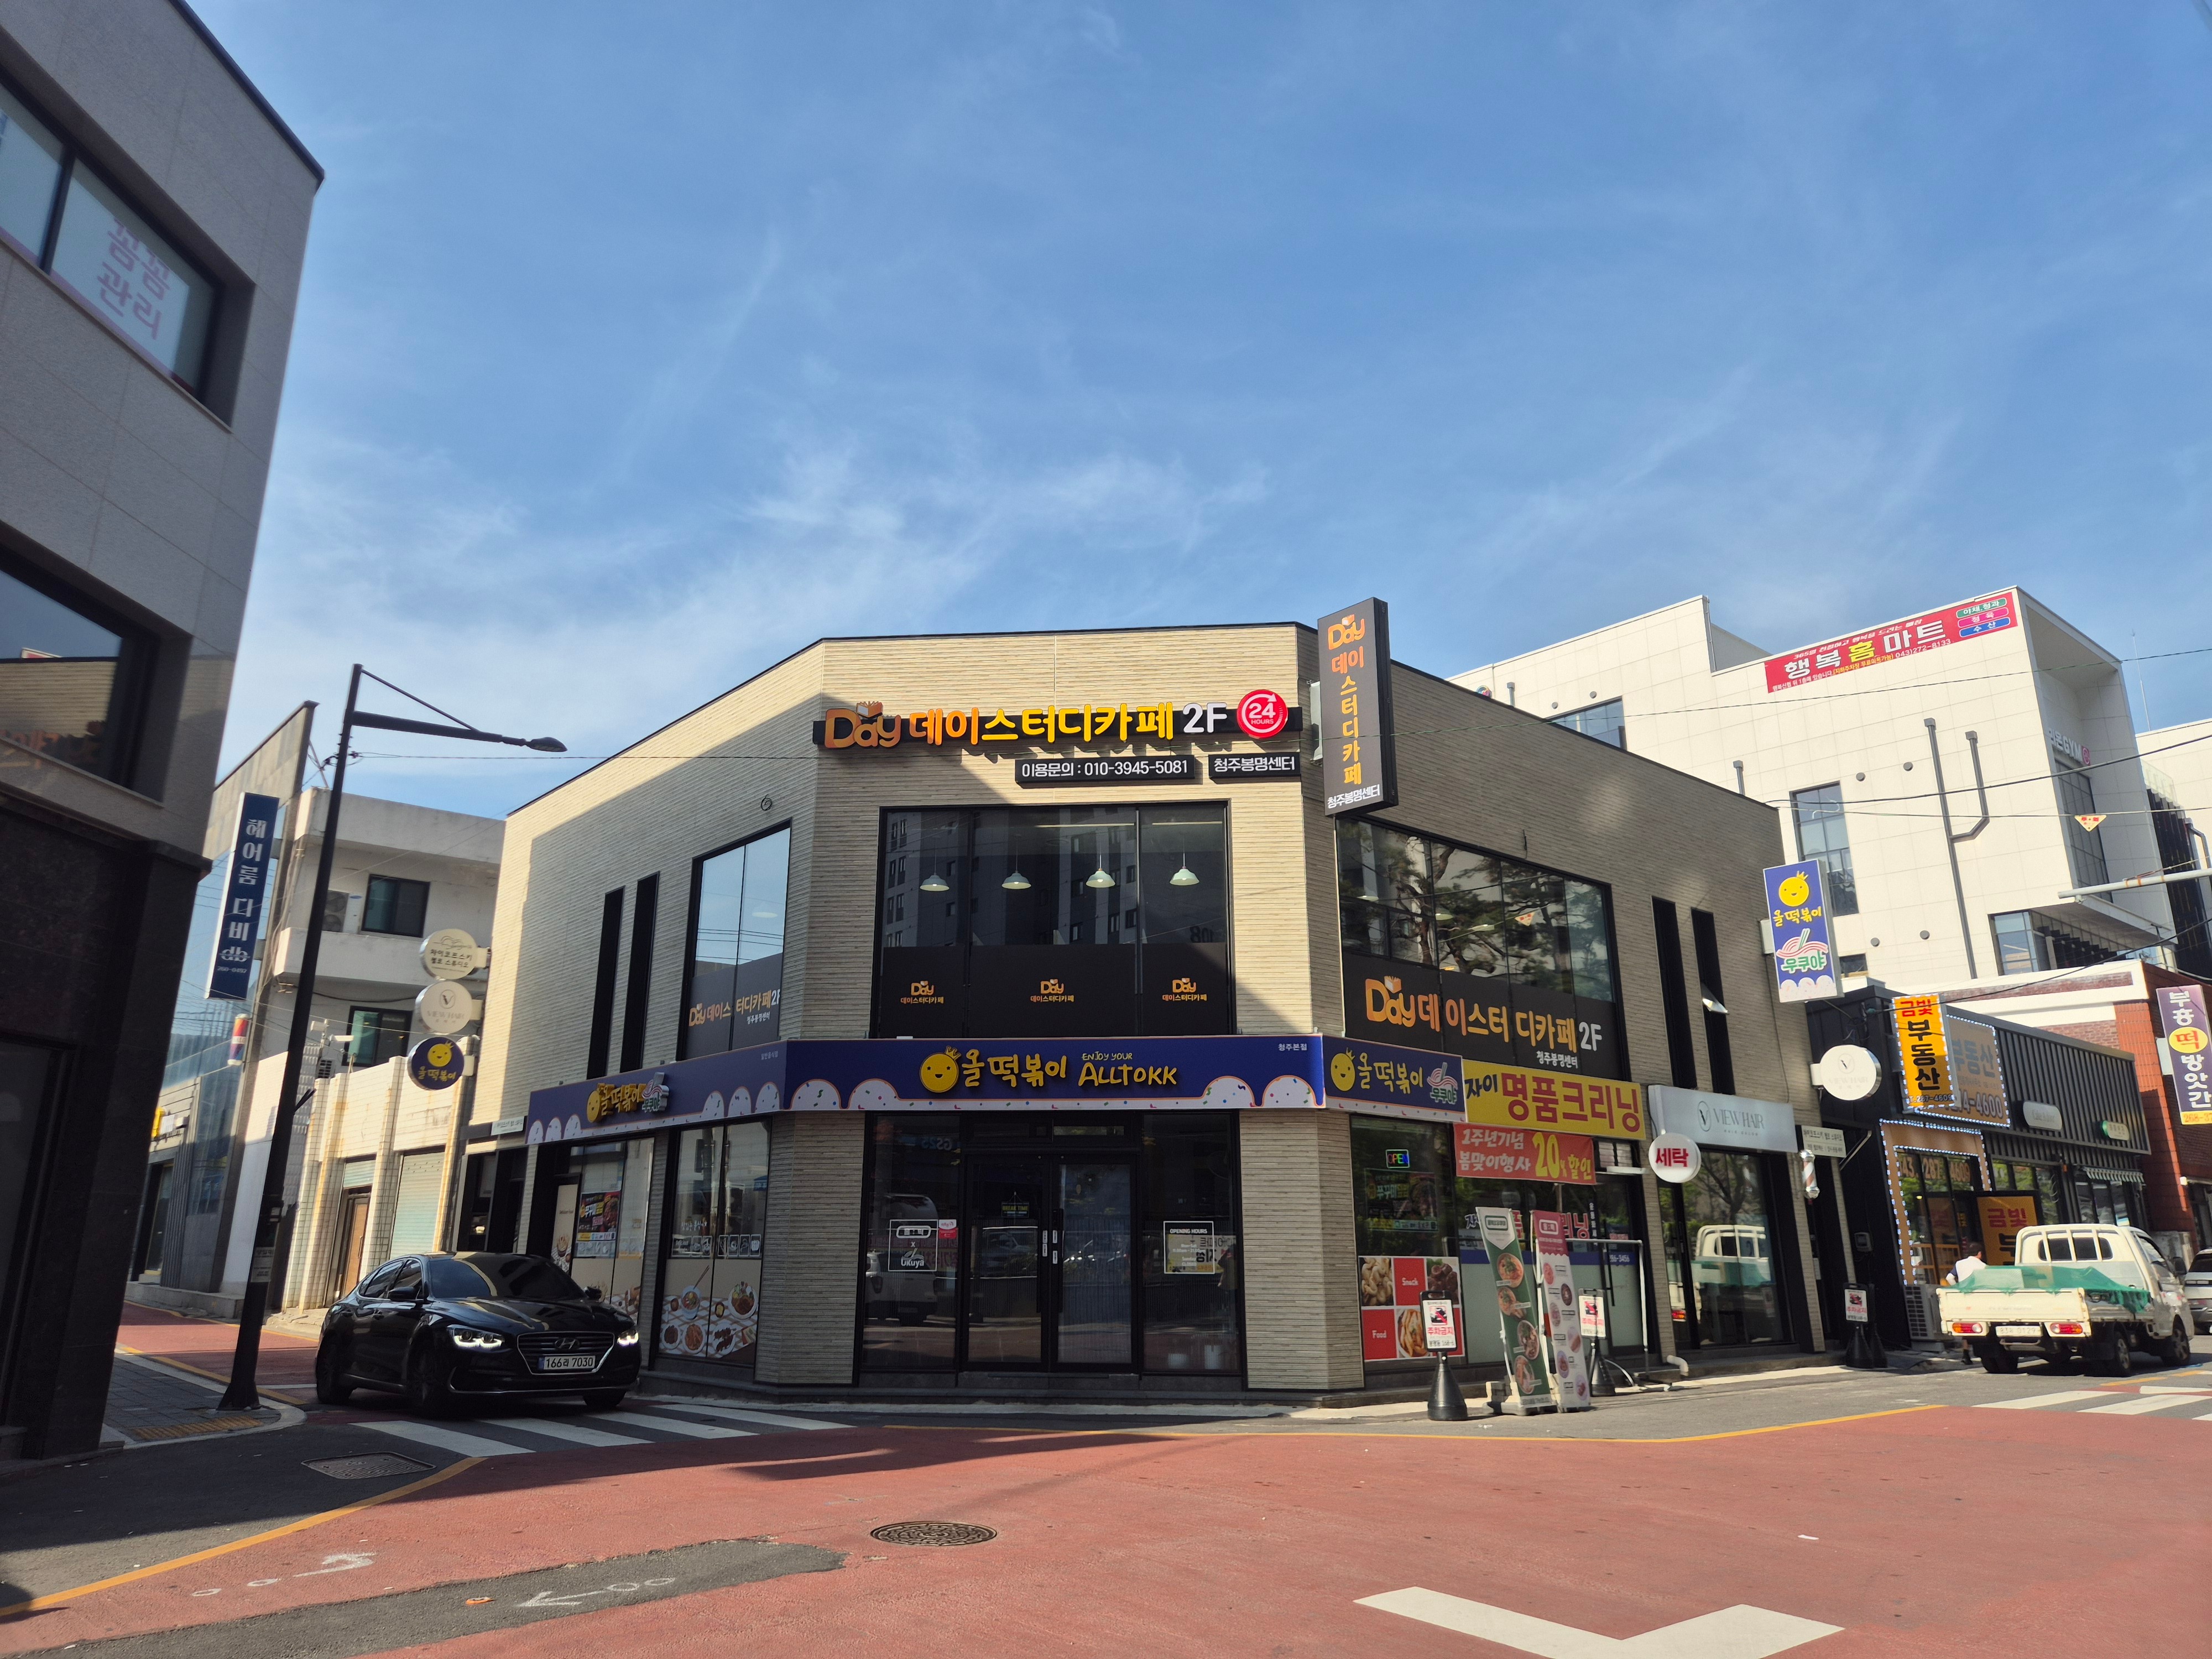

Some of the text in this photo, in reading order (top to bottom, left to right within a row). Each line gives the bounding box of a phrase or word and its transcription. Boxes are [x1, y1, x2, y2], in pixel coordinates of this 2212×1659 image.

[97, 261, 163, 340] 관리
[1328, 618, 1366, 650] Day
[1973, 621, 1996, 633] 수산
[1896, 638, 1952, 659] 043)272-8133
[1249, 703, 1276, 718] 24
[825, 701, 1228, 749] Day 데이스터디카페 2F
[1022, 762, 1074, 778] 이용문의
[1084, 760, 1187, 776] 010-3945-5081
[1214, 757, 1296, 773] 청주봉명센터
[1327, 784, 1380, 808] 청주봉명센터
[1773, 905, 1823, 927] 올떡볶이
[1781, 951, 1827, 974] 우쿠야
[911, 982, 935, 995] Day
[1041, 980, 1065, 994] Day
[1172, 979, 1197, 993] Day
[900, 996, 944, 1004] 데이스터디카페
[1030, 994, 1074, 1003] 데이스터디카페
[1162, 993, 1208, 1002] 데이스터디카페
[688, 1006, 707, 1027] Day
[1365, 978, 1416, 1027] Day
[1578, 1021, 1603, 1052] 2F
[1901, 999, 1934, 1018] 금빛
[1110, 1052, 1133, 1061] YOUR
[1278, 1043, 1307, 1051] 청주본점
[1908, 1019, 1940, 1091] 부동산
[961, 1048, 1067, 1088] 올떡볶이
[1536, 1050, 1579, 1069] 청주봉명센터
[418, 1066, 457, 1082] 올떡볶이
[1078, 1062, 1177, 1087] ALLTOKK
[1358, 1053, 1458, 1105] 올떡볶이 우쿠야
[1464, 1073, 1641, 1133] 자이 명품크리닝
[1462, 1128, 1524, 1150] 1주년기념
[1387, 1154, 1410, 1164] OPEN
[1459, 1150, 1531, 1173] 봄맞이행사
[1655, 1147, 1689, 1168] 세탁
[1568, 1155, 1592, 1181] 할인
[1986, 1207, 2028, 1229] 금빛
[1401, 1277, 1419, 1286] Snack
[1371, 1330, 1387, 1339] Food
[1427, 1327, 1454, 1336] 주차금지
[572, 1357, 594, 1368] 7030
